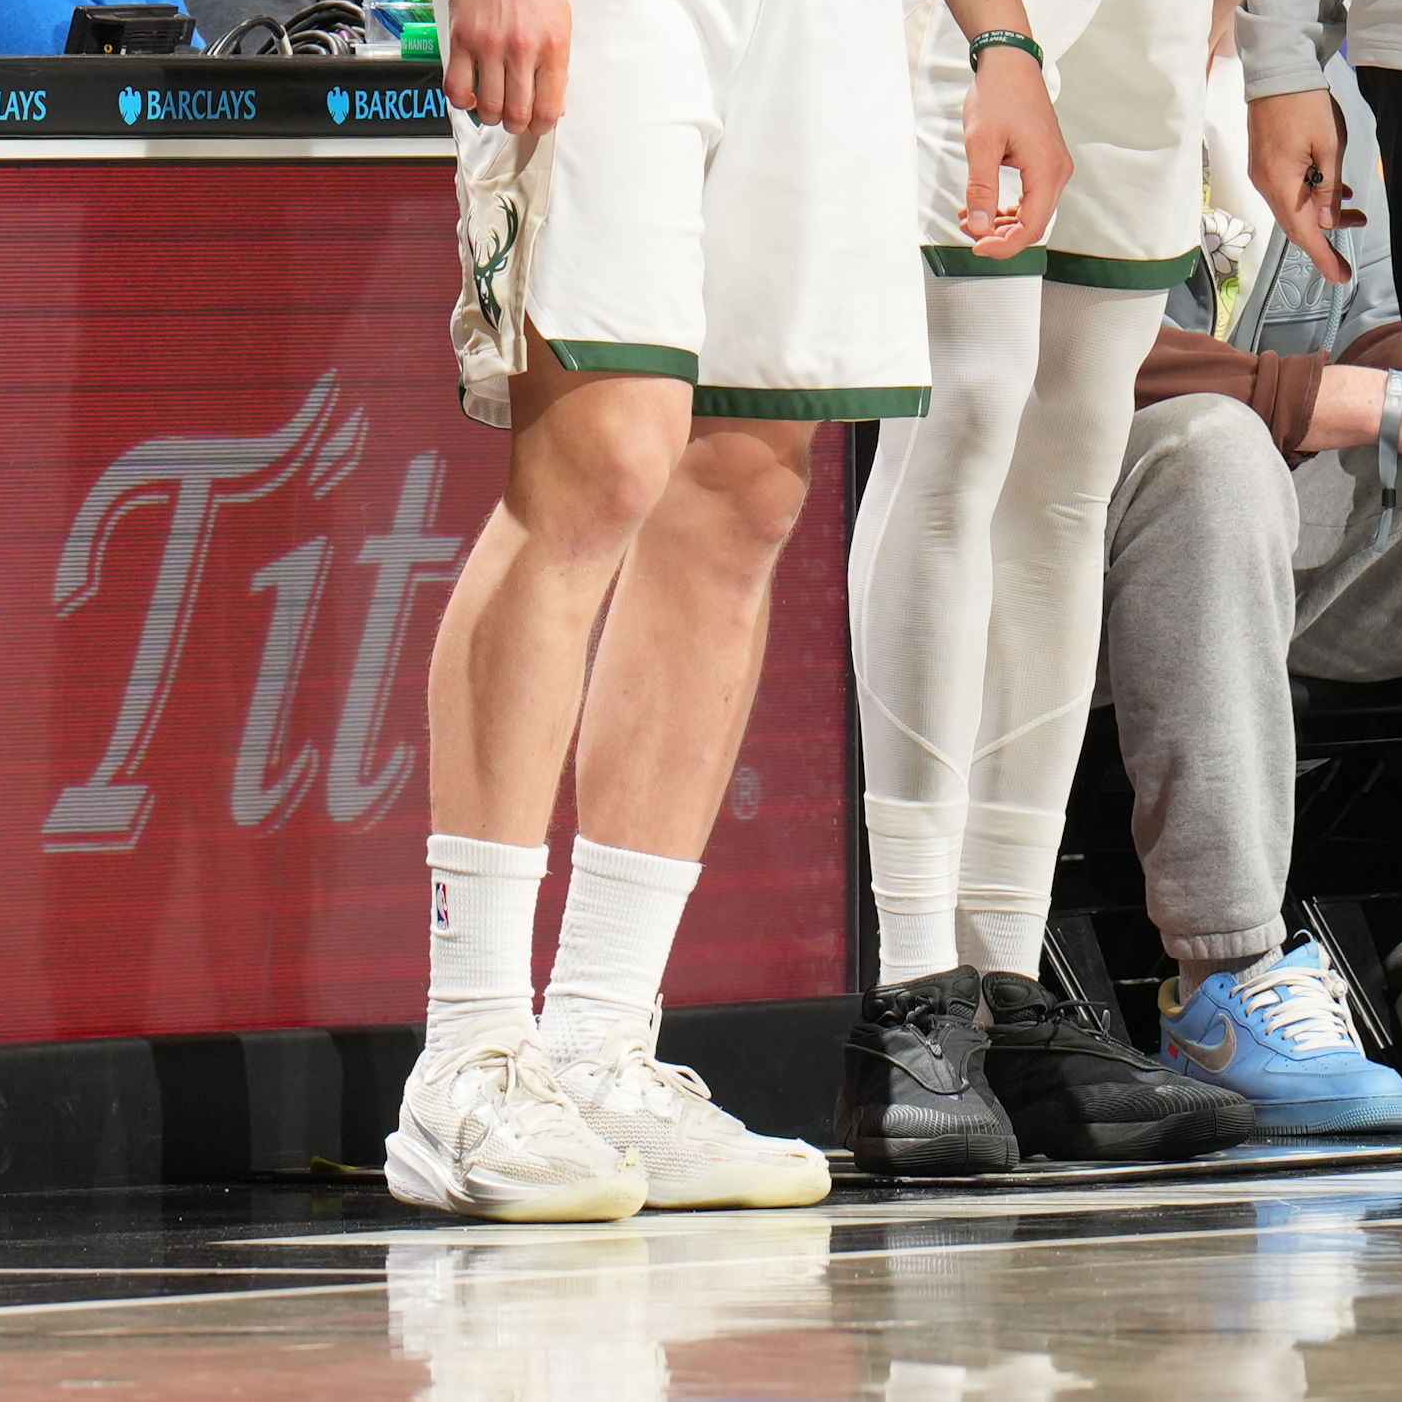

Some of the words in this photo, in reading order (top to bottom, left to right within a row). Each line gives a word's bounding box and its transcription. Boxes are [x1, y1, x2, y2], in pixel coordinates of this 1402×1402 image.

[408, 38, 434, 51] HANDS
[147, 90, 257, 120] BARCLAYS
[355, 88, 446, 120] BARCLAY
[41, 367, 470, 854] Tit
